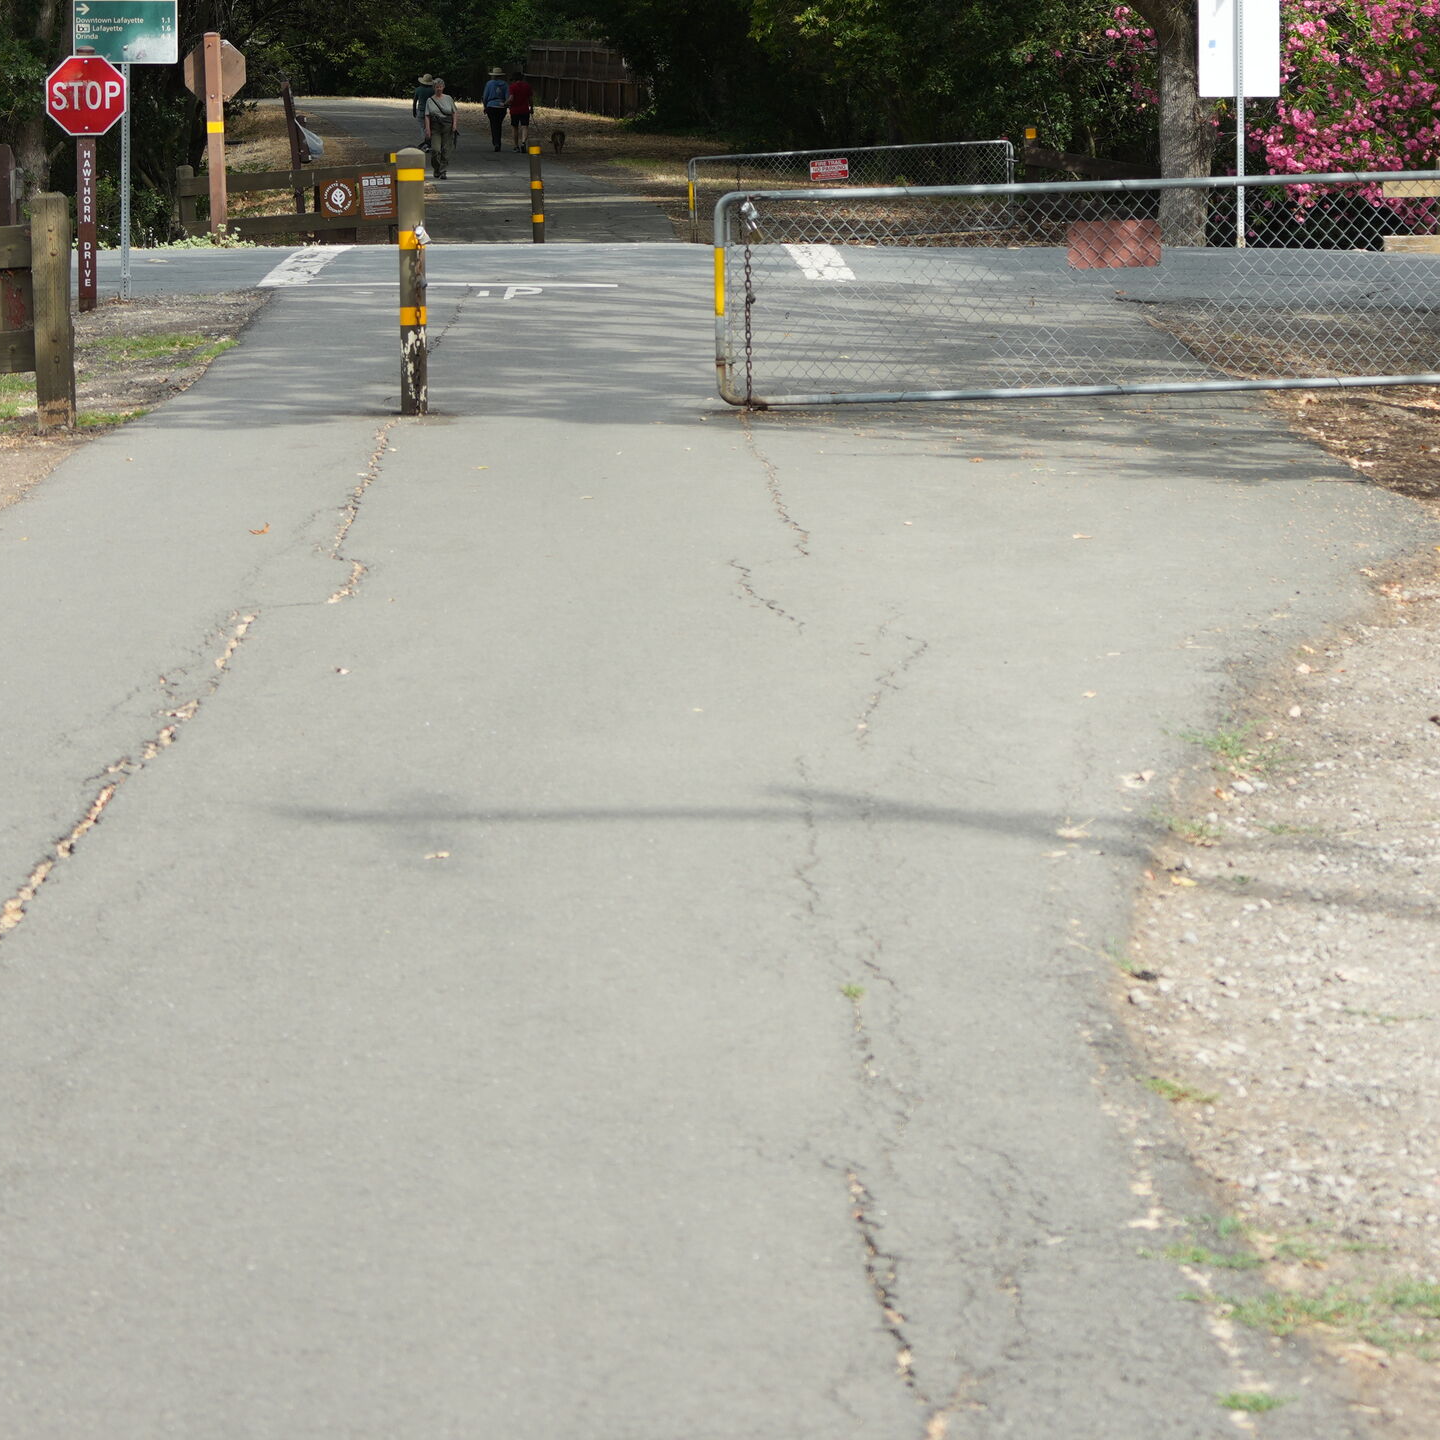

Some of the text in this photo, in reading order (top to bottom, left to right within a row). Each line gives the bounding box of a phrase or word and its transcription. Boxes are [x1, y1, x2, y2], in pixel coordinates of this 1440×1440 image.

[92, 24, 123, 33] Lafayette
[113, 17, 144, 25] Lafayette
[51, 81, 121, 111] STOP
[82, 150, 92, 287] HAWTHORN DRIVE
